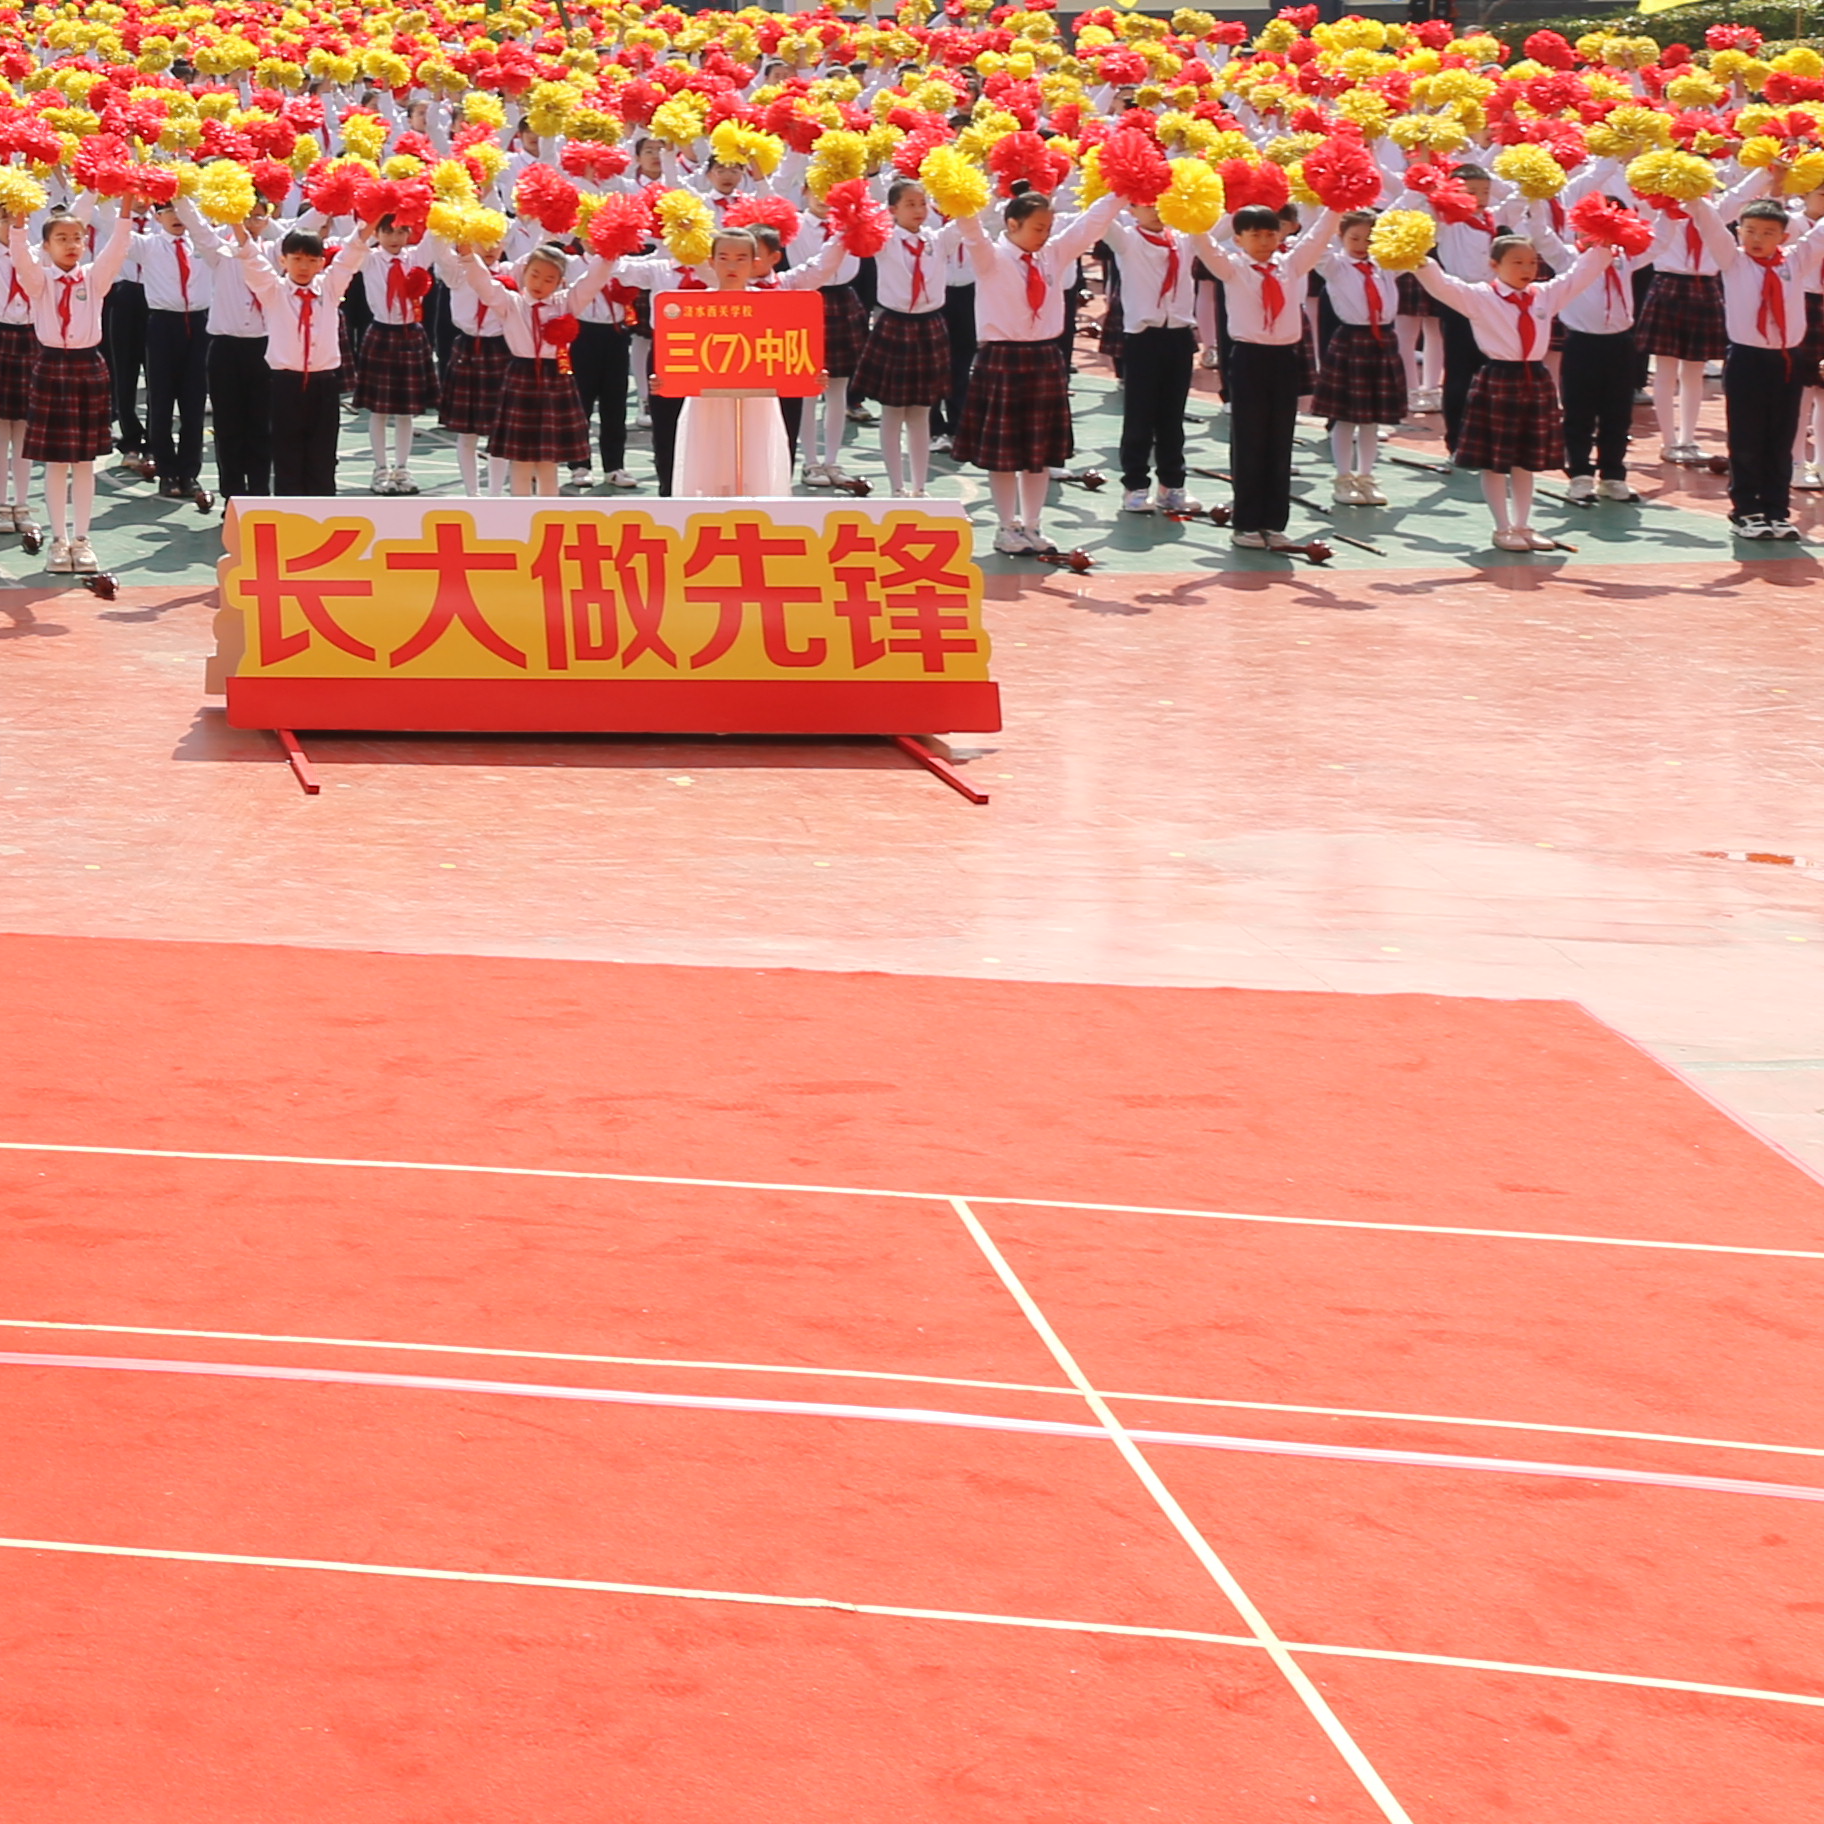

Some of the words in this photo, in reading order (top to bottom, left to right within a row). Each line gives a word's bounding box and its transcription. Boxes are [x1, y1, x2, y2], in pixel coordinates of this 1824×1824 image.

[664, 328, 816, 377] 三(7)中队
[239, 522, 978, 673] 长大做先锋
